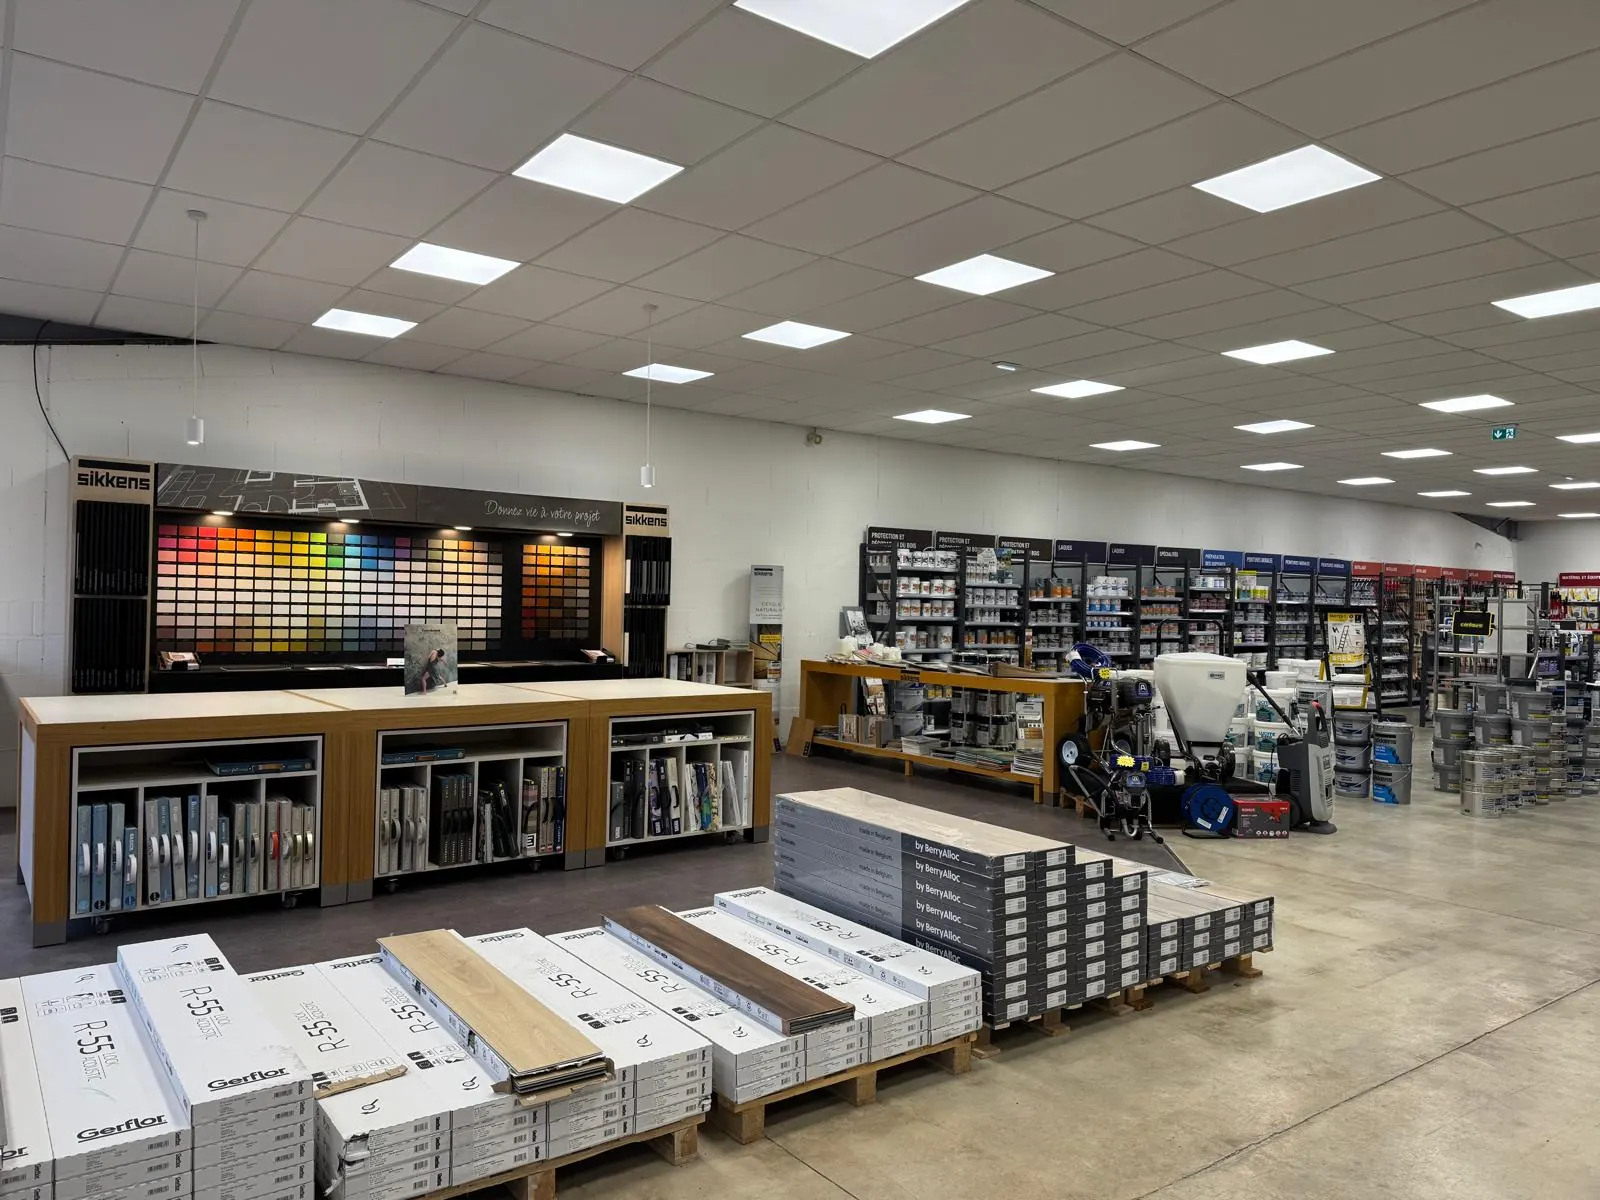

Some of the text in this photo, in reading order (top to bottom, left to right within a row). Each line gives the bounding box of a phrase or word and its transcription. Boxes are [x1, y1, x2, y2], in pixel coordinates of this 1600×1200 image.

[78, 470, 150, 490] sikkens
[484, 500, 600, 527] Donnez vie à votre projet
[626, 514, 667, 527] sikkens
[915, 841, 960, 862] by BerryAlloc
[915, 860, 960, 881] by BerryAlloc
[916, 880, 961, 902] by BerryAlloc
[916, 900, 962, 923] by BerryAlloc
[916, 919, 961, 943] by BerryAlloc
[330, 956, 384, 969] Gerflor
[248, 970, 304, 982] Gerflor
[548, 973, 598, 999] R-55
[636, 969, 687, 993] R-55
[179, 986, 224, 1016] R-55
[391, 1004, 439, 1033] R-55
[73, 1020, 115, 1054] R-55
[302, 1020, 350, 1052] R-55
[207, 1068, 289, 1091] Gerflor
[76, 1114, 168, 1142] Gerflor
